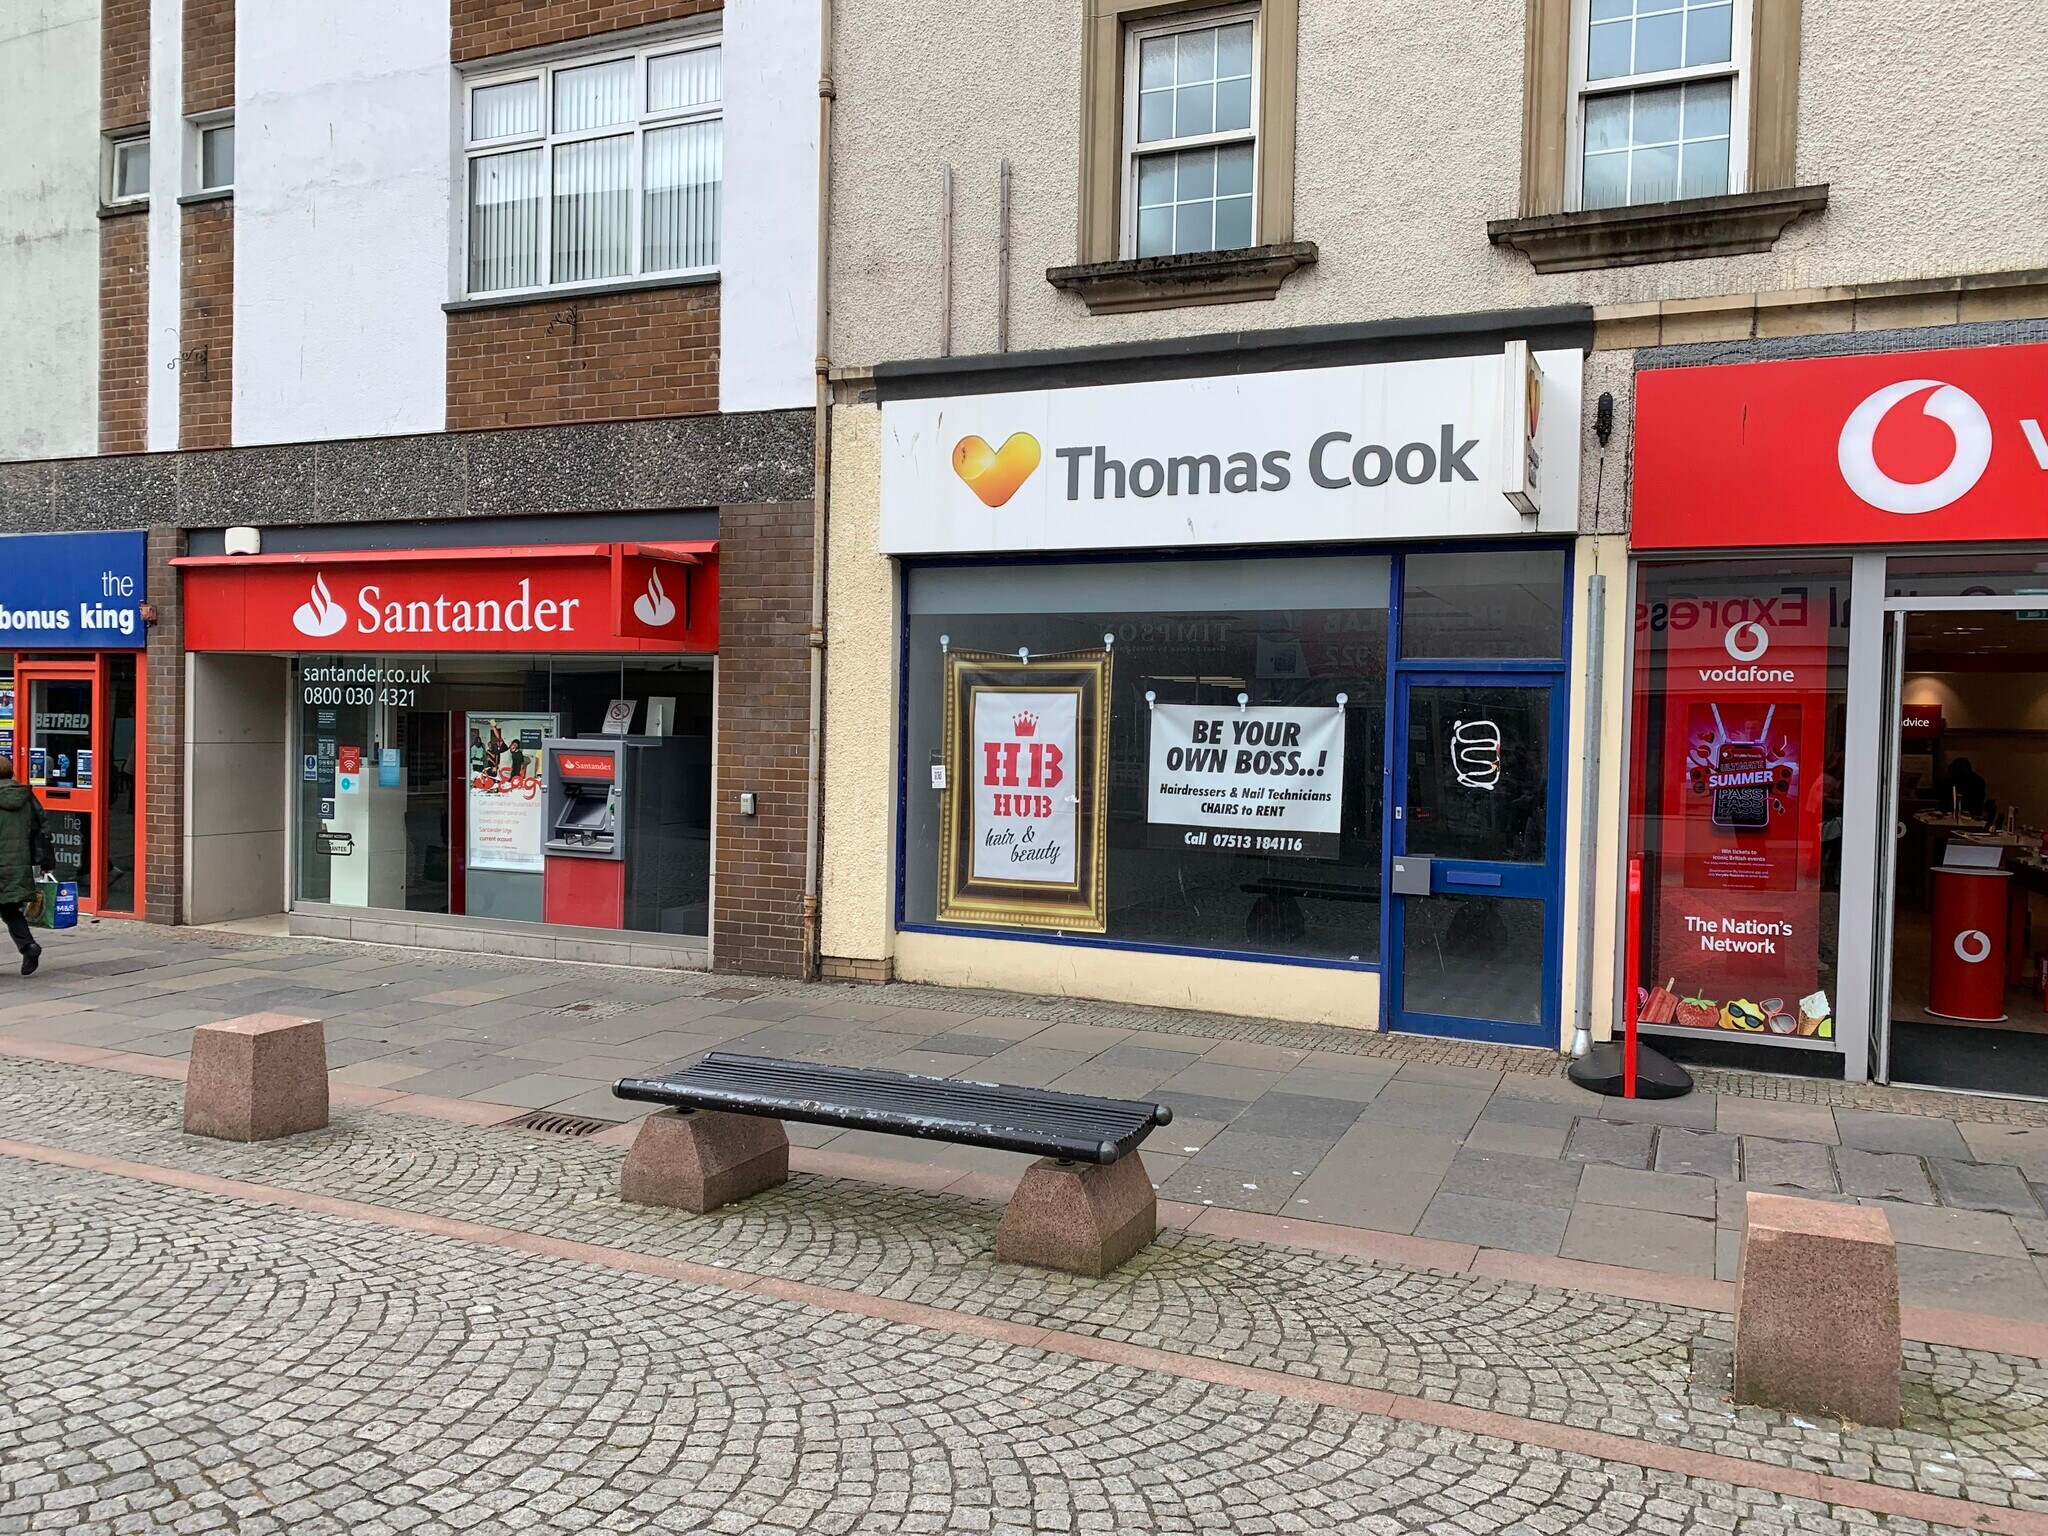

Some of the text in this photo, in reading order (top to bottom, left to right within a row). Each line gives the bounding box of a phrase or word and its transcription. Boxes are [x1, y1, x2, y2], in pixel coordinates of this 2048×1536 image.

[1056, 444, 1291, 501] Thomas
[1308, 423, 1481, 489] Cook
[101, 570, 134, 597] the
[357, 577, 580, 634] Santander
[0, 602, 135, 635] bonus king
[303, 663, 431, 685] santander.co.uk
[1699, 665, 1795, 683] vodafone
[304, 686, 416, 708] 0800 030 4321
[35, 713, 89, 729] BETFRED
[1191, 720, 1301, 747] BE YOUR
[574, 761, 612, 771] Santander
[984, 742, 1064, 788] HB
[1166, 747, 1328, 777] OWN BOSS..!
[1708, 770, 1774, 788] SUMMER
[1159, 783, 1332, 801] Hairdressers & Nail Technicians
[1719, 788, 1764, 800] PASS
[993, 793, 1053, 818] HUB
[1200, 802, 1286, 817] CHAIRS to RENT
[64, 814, 82, 830] the
[985, 825, 1035, 847] hair &
[1184, 832, 1303, 851] Call 07513 184116
[1010, 840, 1061, 864] beauty
[56, 904, 75, 912] M&S
[1684, 916, 1793, 936] The Nation's
[1701, 935, 1776, 954] Network
